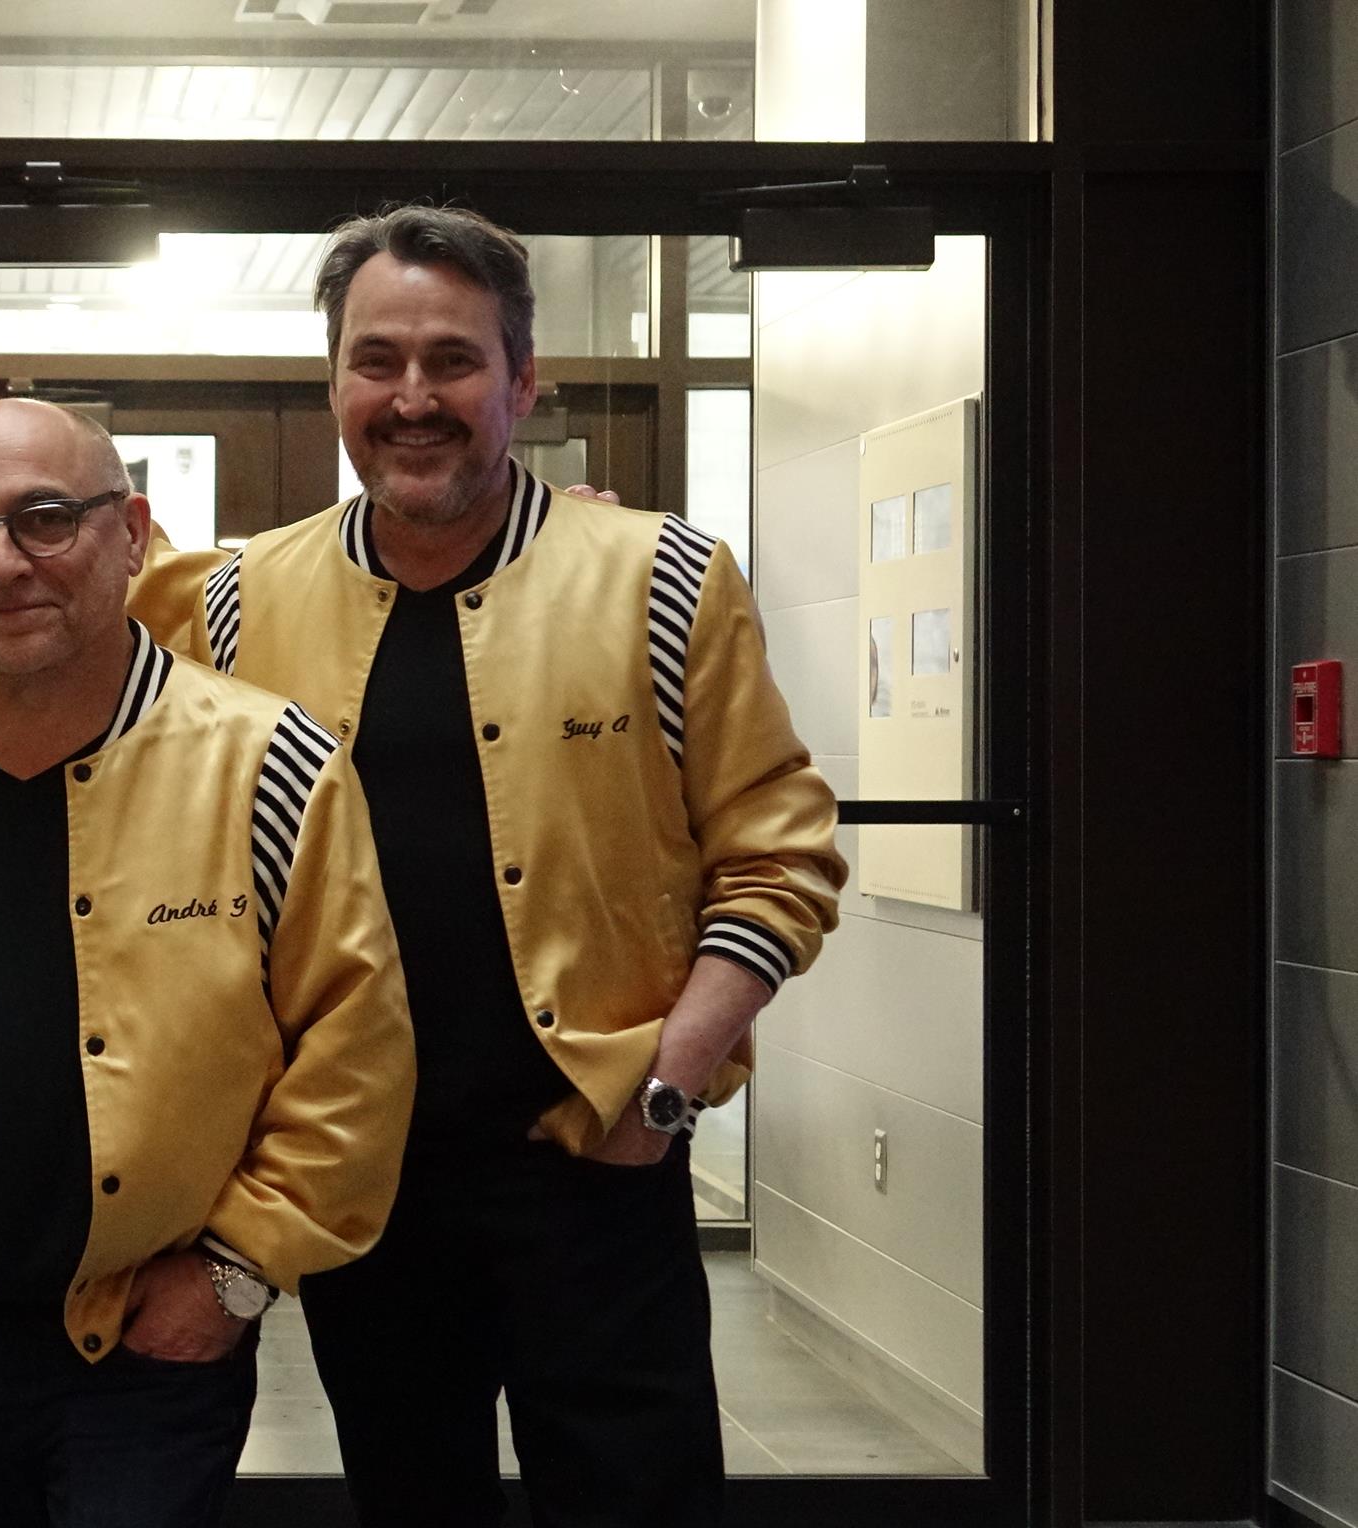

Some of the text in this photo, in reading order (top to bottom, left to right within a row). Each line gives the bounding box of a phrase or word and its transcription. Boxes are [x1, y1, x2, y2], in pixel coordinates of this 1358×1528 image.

[561, 714, 630, 740] Guy A
[147, 894, 248, 925] André G
